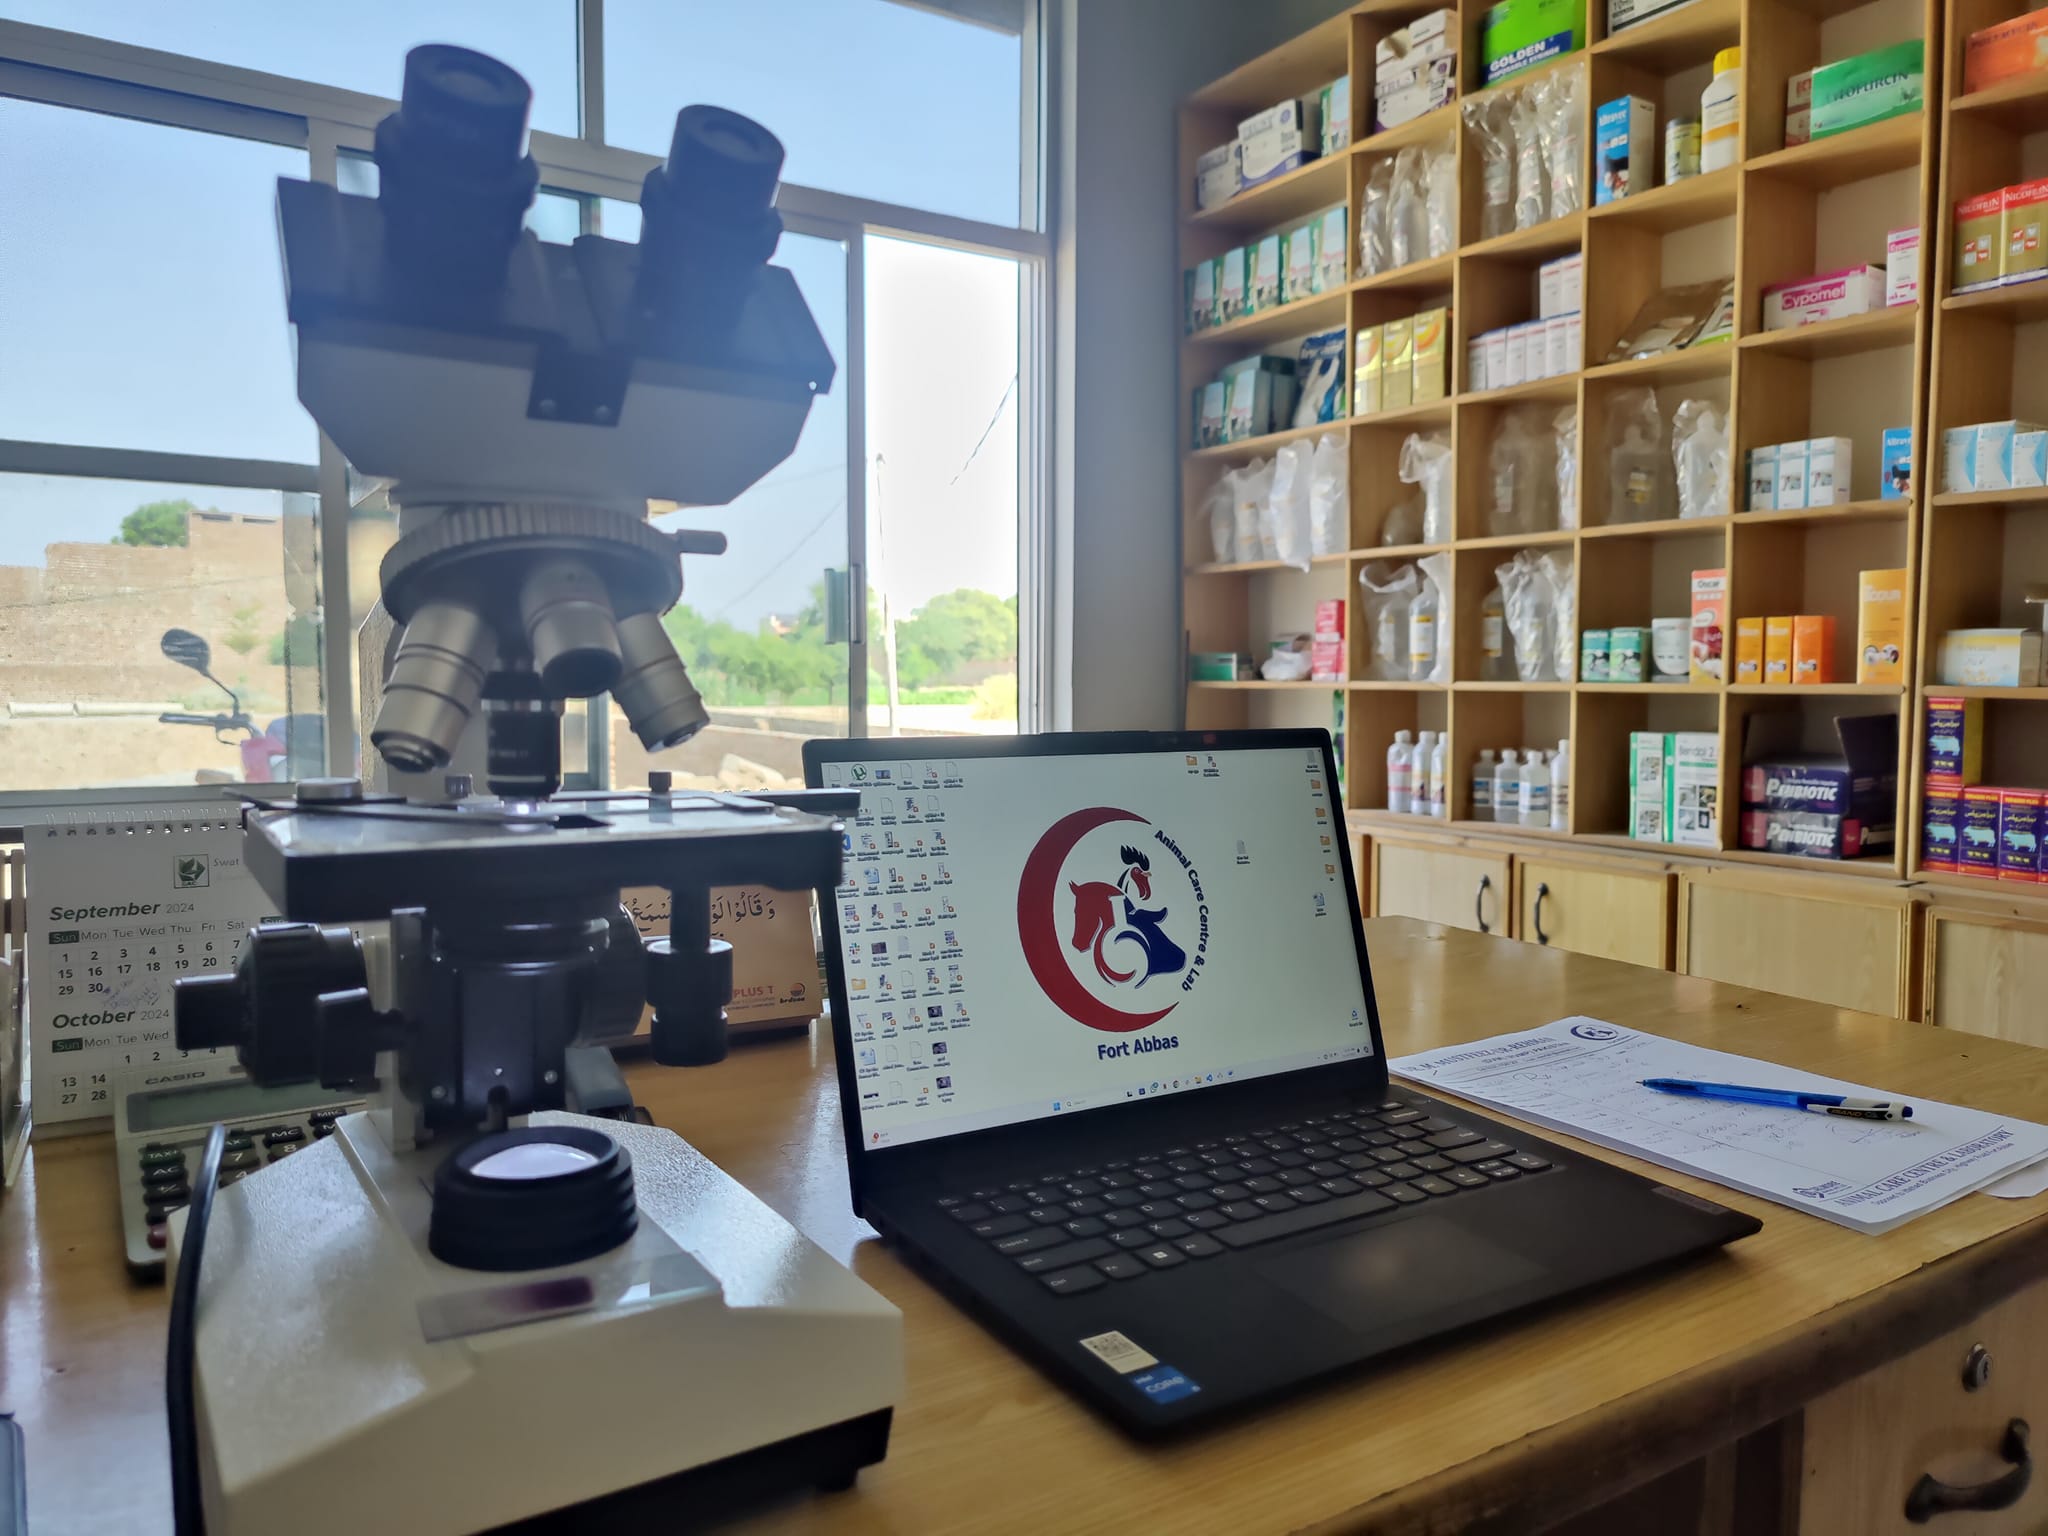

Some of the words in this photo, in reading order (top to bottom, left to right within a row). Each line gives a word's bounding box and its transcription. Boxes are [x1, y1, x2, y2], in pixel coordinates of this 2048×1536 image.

[1489, 40, 1546, 73] GOLDEN
[1154, 829, 1192, 869] Animal
[1188, 869, 1204, 902] Care
[49, 902, 161, 922] September
[166, 903, 195, 914] 2024
[53, 932, 78, 943] Sun
[81, 931, 107, 940] Mon
[112, 929, 133, 938] Tue
[140, 926, 165, 936] Wed
[170, 924, 192, 934] Thu
[202, 922, 216, 932] Fri
[227, 920, 245, 930] Sat
[1197, 904, 1210, 953] Centre
[62, 953, 69, 962] 1
[91, 951, 99, 960] 2
[120, 948, 128, 958] 3
[148, 946, 157, 956] 4
[177, 944, 185, 954] 5
[205, 942, 213, 952] 6
[233, 940, 240, 949] 7
[1193, 954, 1205, 966] &
[58, 968, 73, 979] 15
[88, 966, 103, 976] 16
[117, 964, 132, 974] 17
[146, 962, 160, 972] 18
[174, 960, 190, 970] 19
[202, 957, 218, 967] 20
[58, 985, 74, 996] 29
[88, 983, 104, 993] 30
[1181, 967, 1200, 992] Lab
[734, 986, 764, 998] PLUS
[768, 986, 774, 994] T
[52, 1010, 136, 1029] October
[140, 1008, 170, 1021] 2024
[56, 1040, 80, 1050] Sun
[85, 1037, 110, 1048] Mon
[117, 1034, 138, 1044] Tue
[142, 1031, 170, 1042] Wed
[1097, 1040, 1130, 1061] Fort
[1134, 1033, 1179, 1056] Abbas
[152, 1052, 160, 1062] 2
[61, 1077, 77, 1088] 13
[91, 1074, 106, 1084] 14
[145, 1071, 206, 1086] CASIO
[62, 1094, 77, 1104] 27
[91, 1090, 107, 1101] 28
[271, 1128, 299, 1138] MC
[153, 1166, 180, 1176] AC
[231, 1152, 244, 1162] 7
[1875, 1175, 1911, 1191] CARE
[1902, 1158, 1949, 1178] CENTRE
